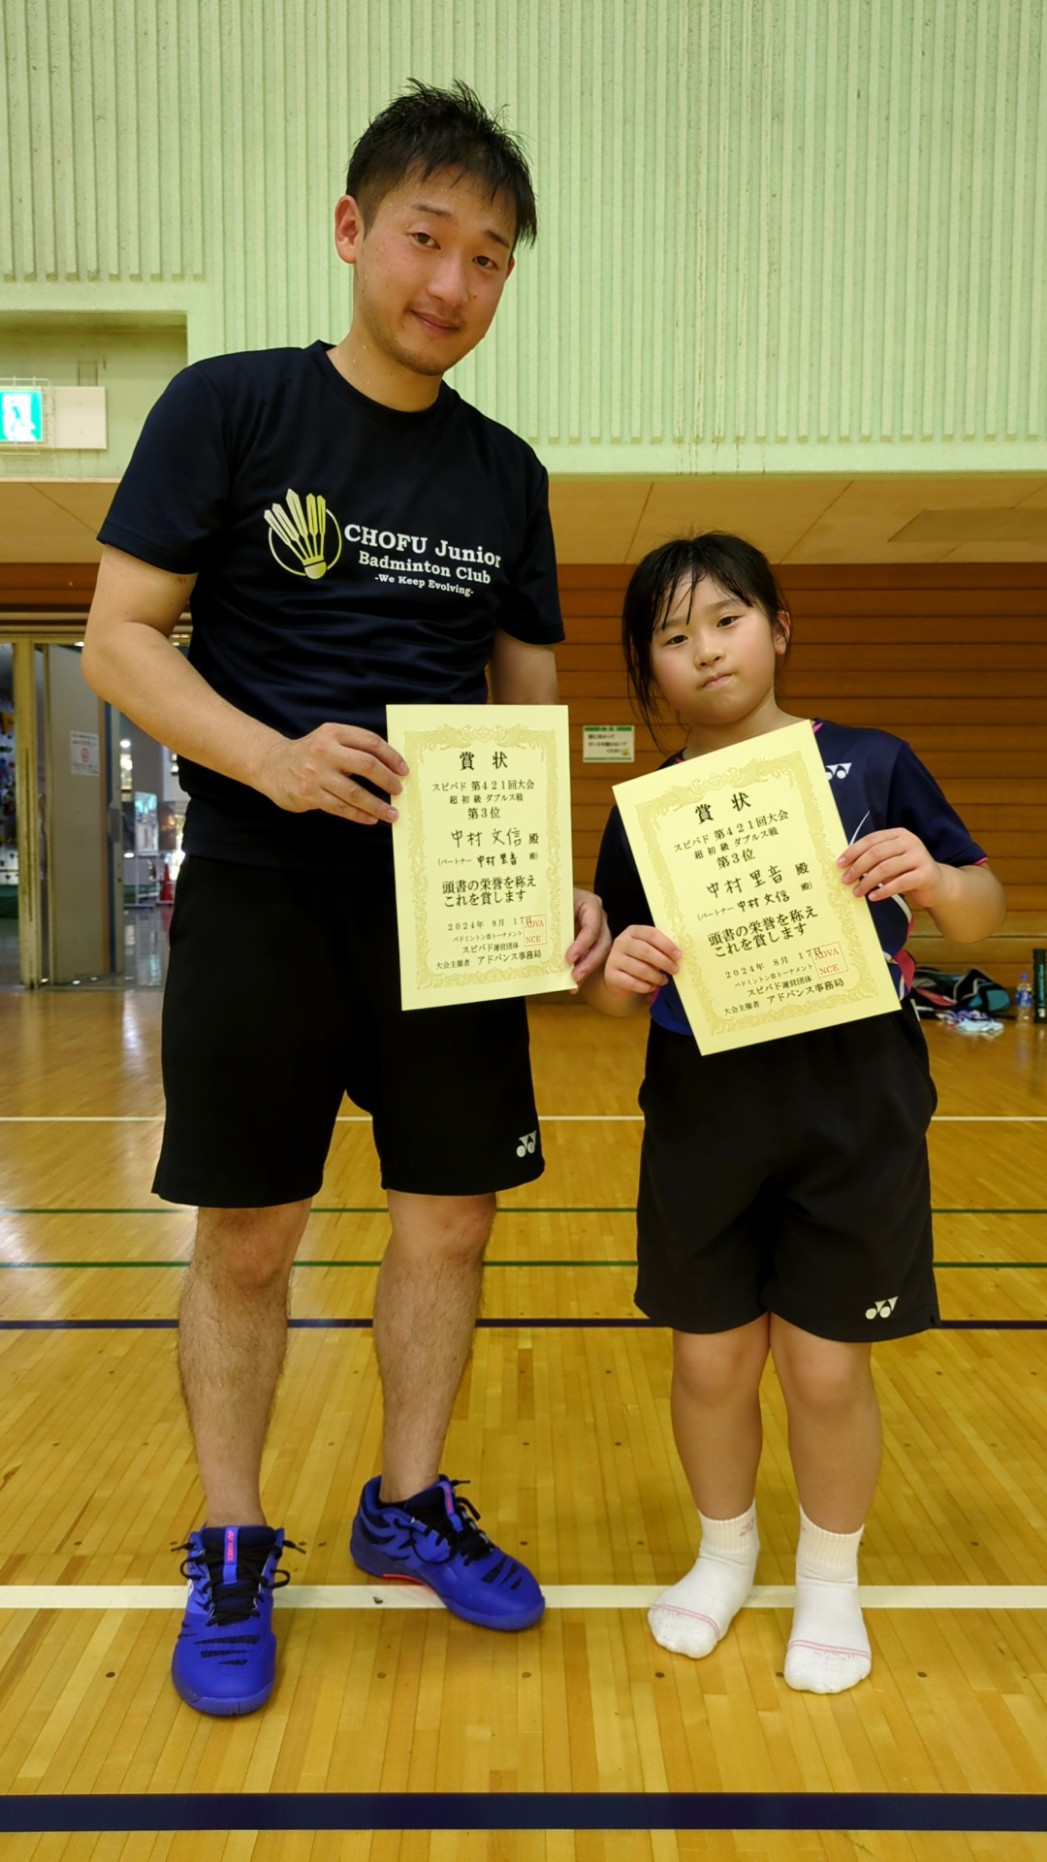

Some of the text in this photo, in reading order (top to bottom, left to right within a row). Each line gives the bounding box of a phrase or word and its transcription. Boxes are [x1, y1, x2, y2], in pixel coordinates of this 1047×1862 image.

[344, 524, 501, 569] CHOFU Junior
[358, 550, 491, 585] Badminton Club
[398, 575, 425, 589] Keep
[467, 806, 501, 820] 第3位
[451, 827, 539, 848] 中村 文信 殿
[477, 854, 495, 868] 中村
[716, 848, 756, 869] 第3位
[442, 875, 536, 894] 頭書の栄誉を称え
[706, 862, 810, 898] 中村 里音 殿
[445, 889, 526, 907] これを賞します
[737, 897, 759, 912] 中村
[707, 906, 818, 946] 頭書の栄誉を称え
[525, 935, 542, 943] NCE
[714, 922, 807, 957] これを賞します
[819, 963, 840, 975] NCE
